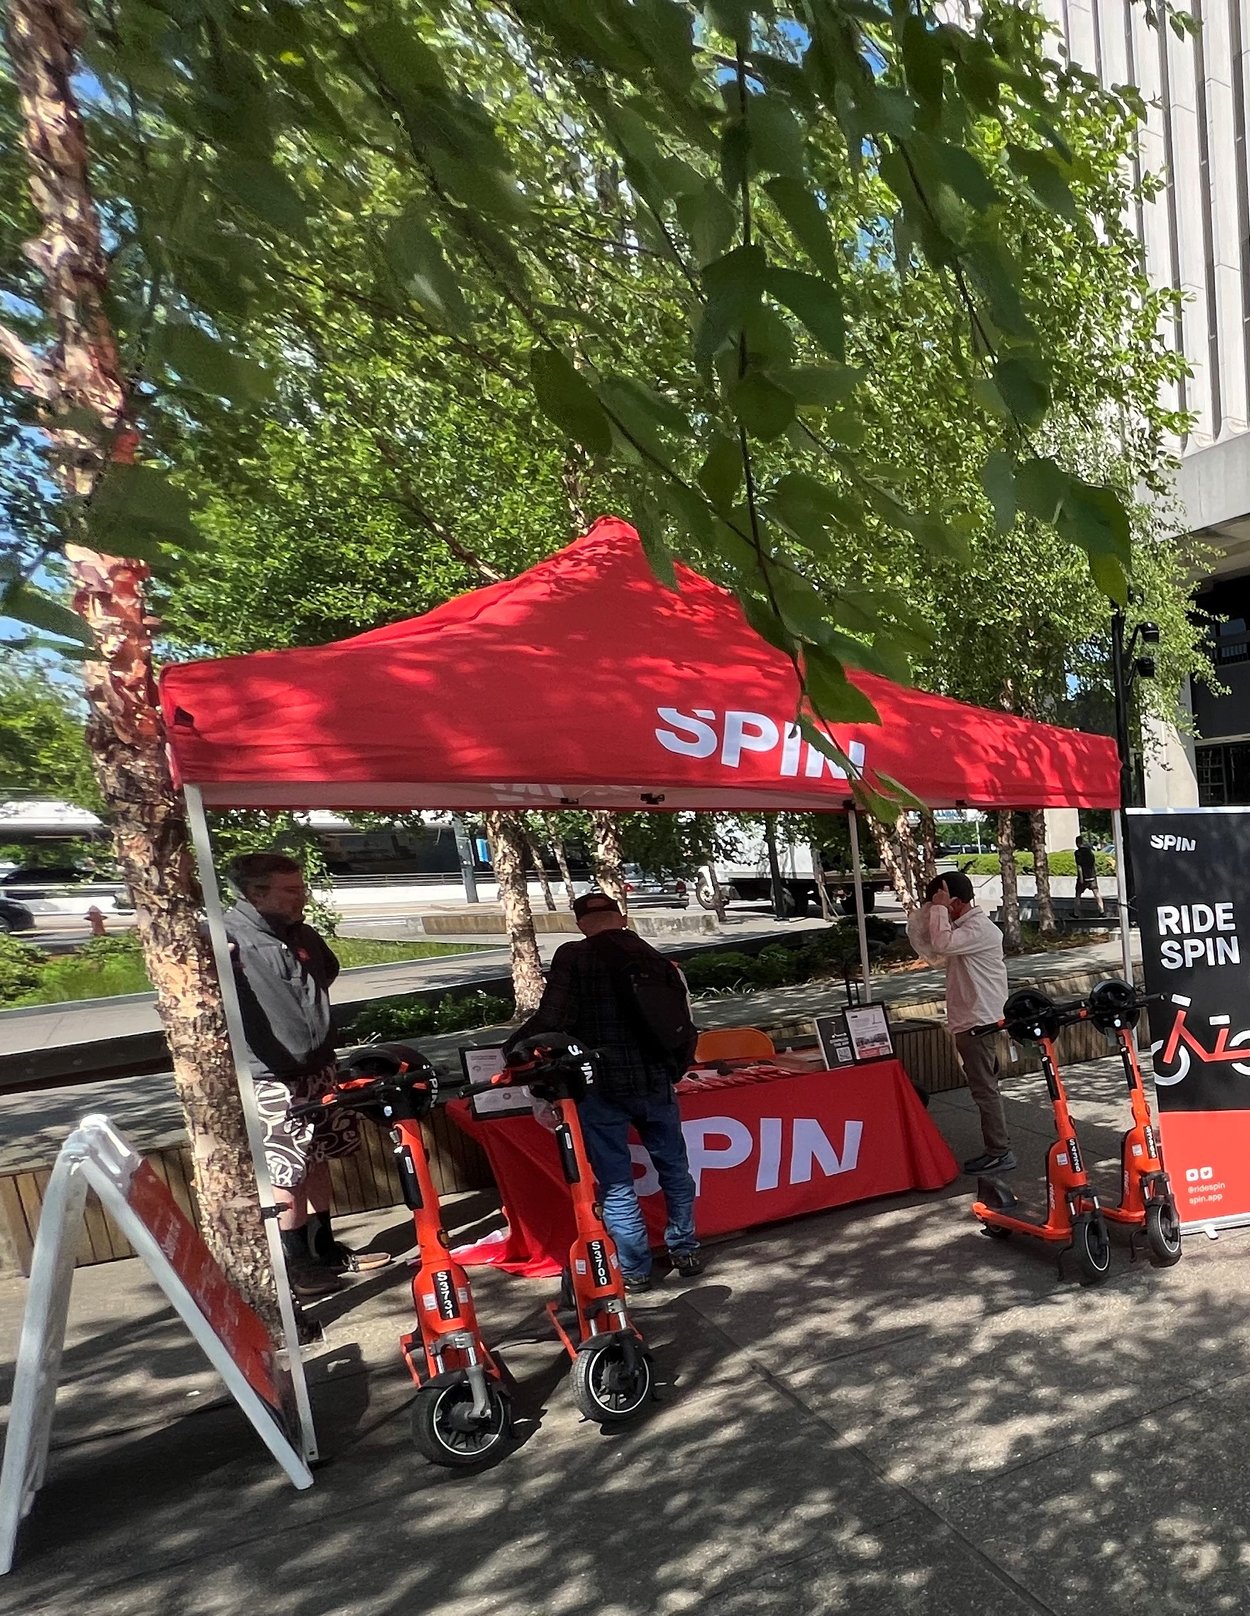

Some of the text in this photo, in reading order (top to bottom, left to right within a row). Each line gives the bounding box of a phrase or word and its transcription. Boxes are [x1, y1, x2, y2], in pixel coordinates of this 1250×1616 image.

[655, 707, 866, 780] SPIN
[1150, 834, 1197, 852] SPIN
[1157, 902, 1236, 936] RIDE
[1160, 936, 1241, 970] SPIN
[1187, 1182, 1226, 1194] @ridespin
[1188, 1194, 1223, 1205] spin.app
[591, 1241, 608, 1286] S3700
[436, 1271, 454, 1319] S3731
